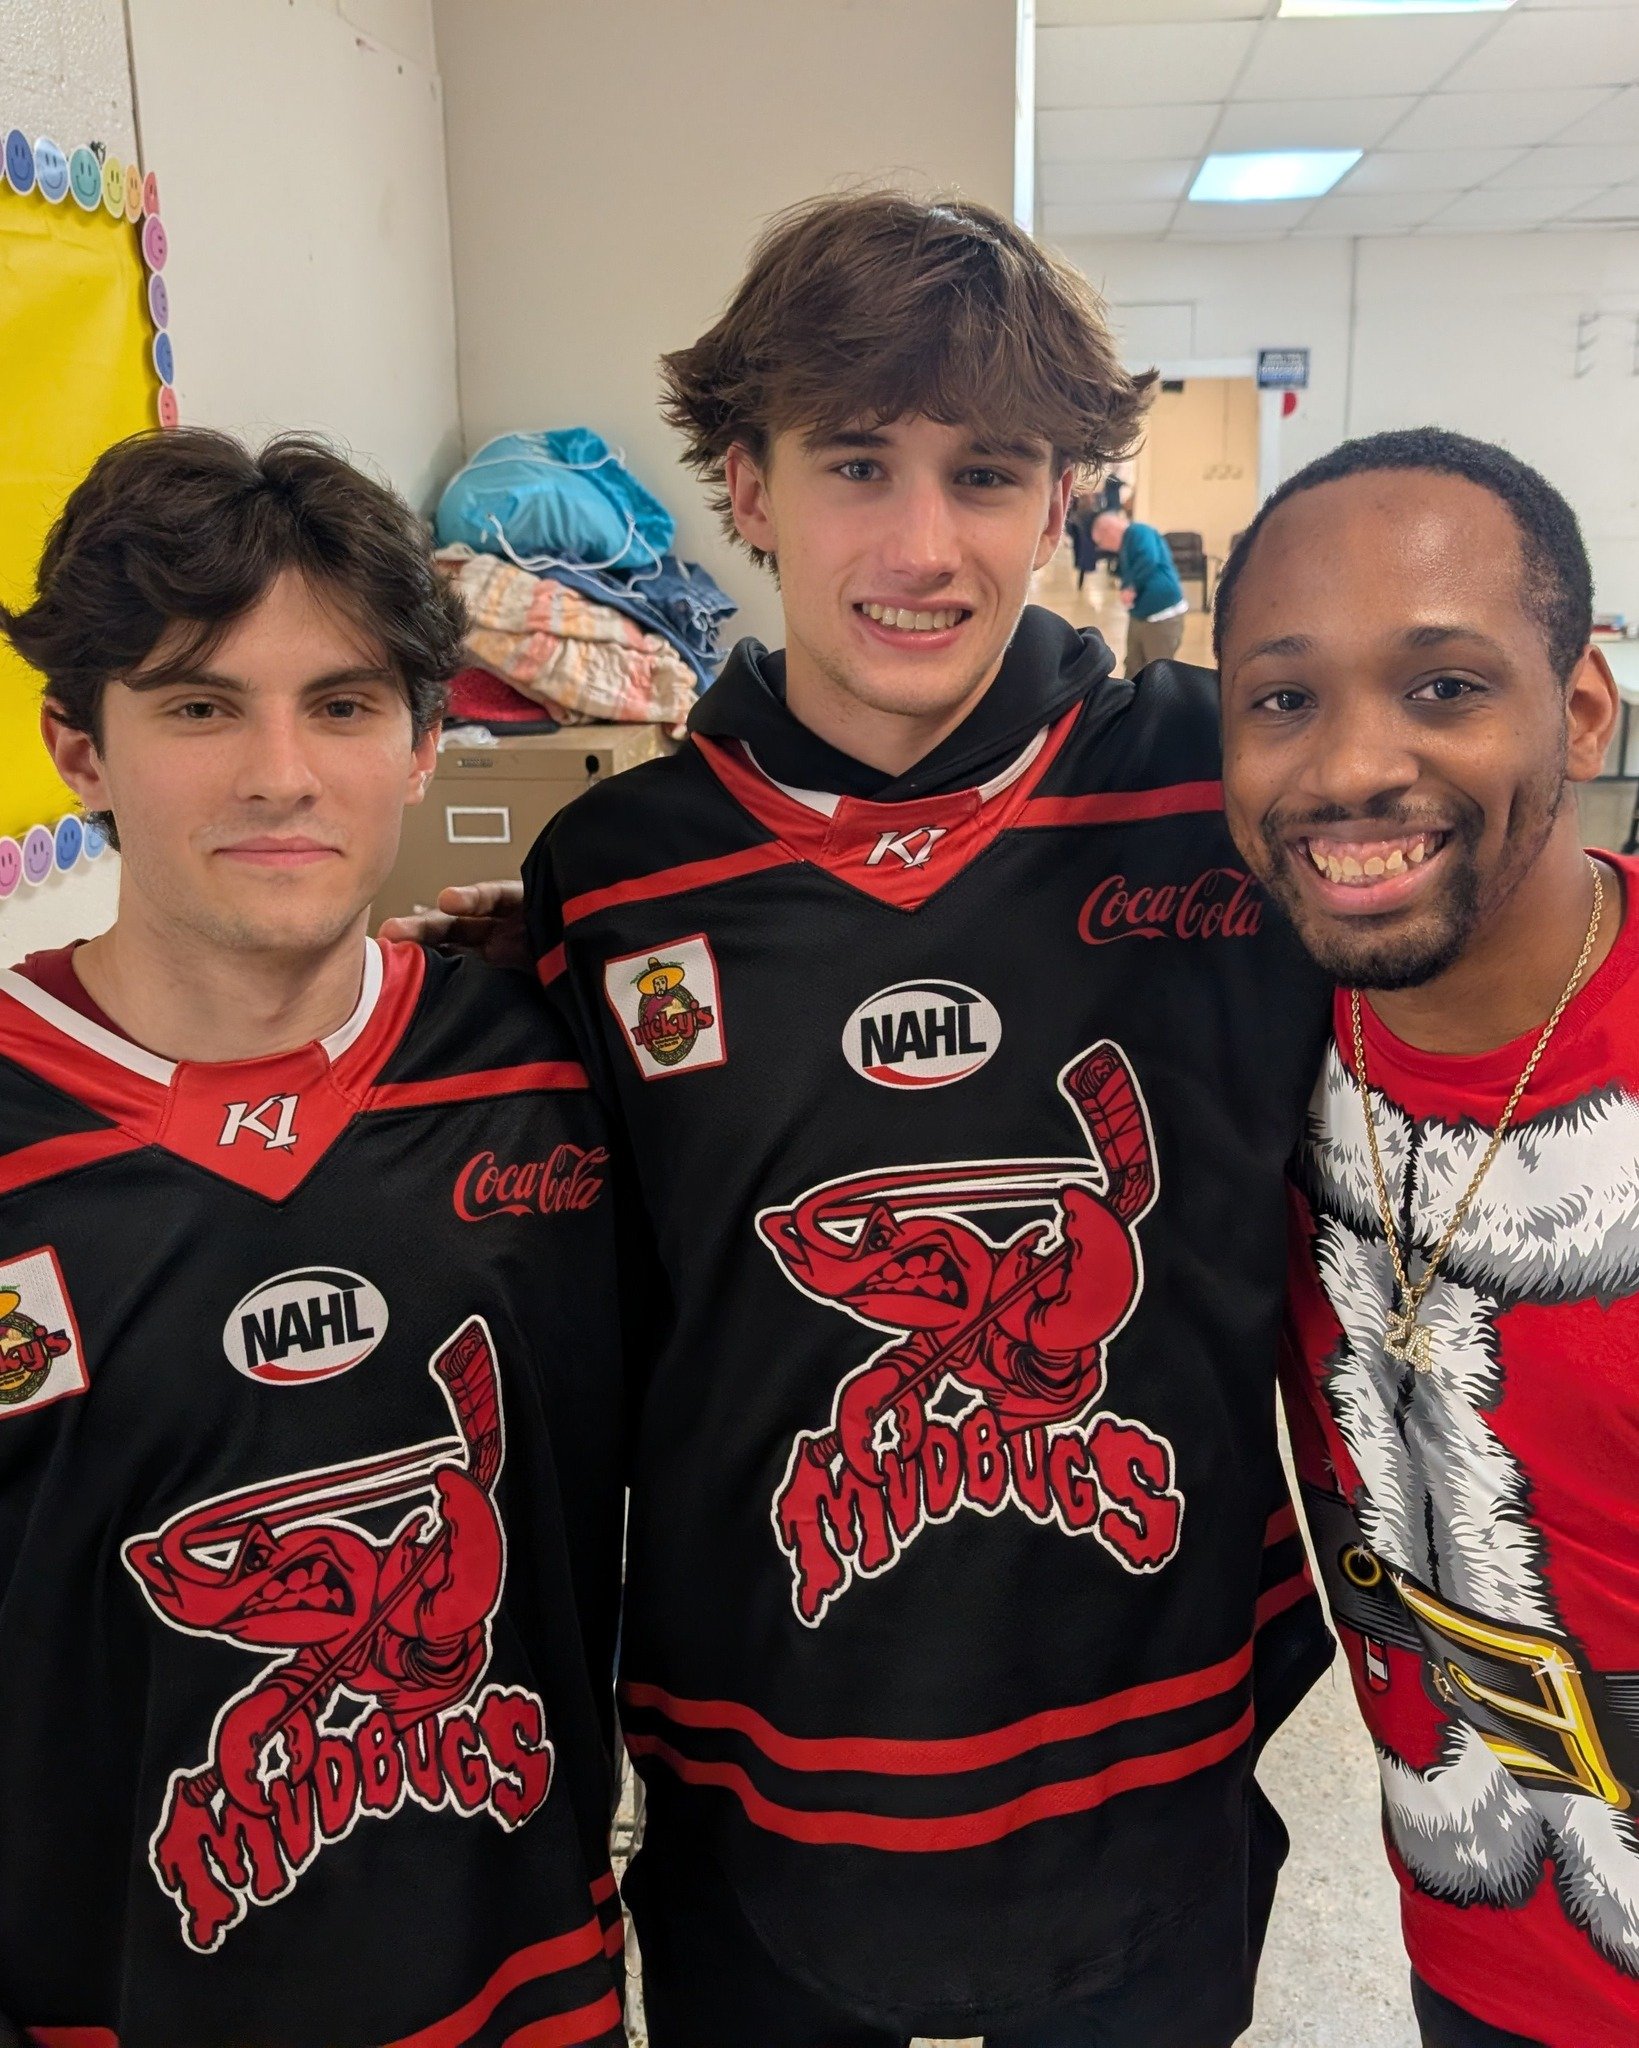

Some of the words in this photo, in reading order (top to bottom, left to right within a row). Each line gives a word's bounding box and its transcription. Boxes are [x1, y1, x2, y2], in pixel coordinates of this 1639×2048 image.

[1077, 867, 1263, 945] Coca-Cola
[860, 1004, 987, 1068] NAHL
[453, 1143, 610, 1222] Coca-Cola
[241, 1289, 375, 1369] NAHL
[772, 1405, 1184, 1627] MUDBUGS
[149, 1683, 554, 1953] MUDBUGS
